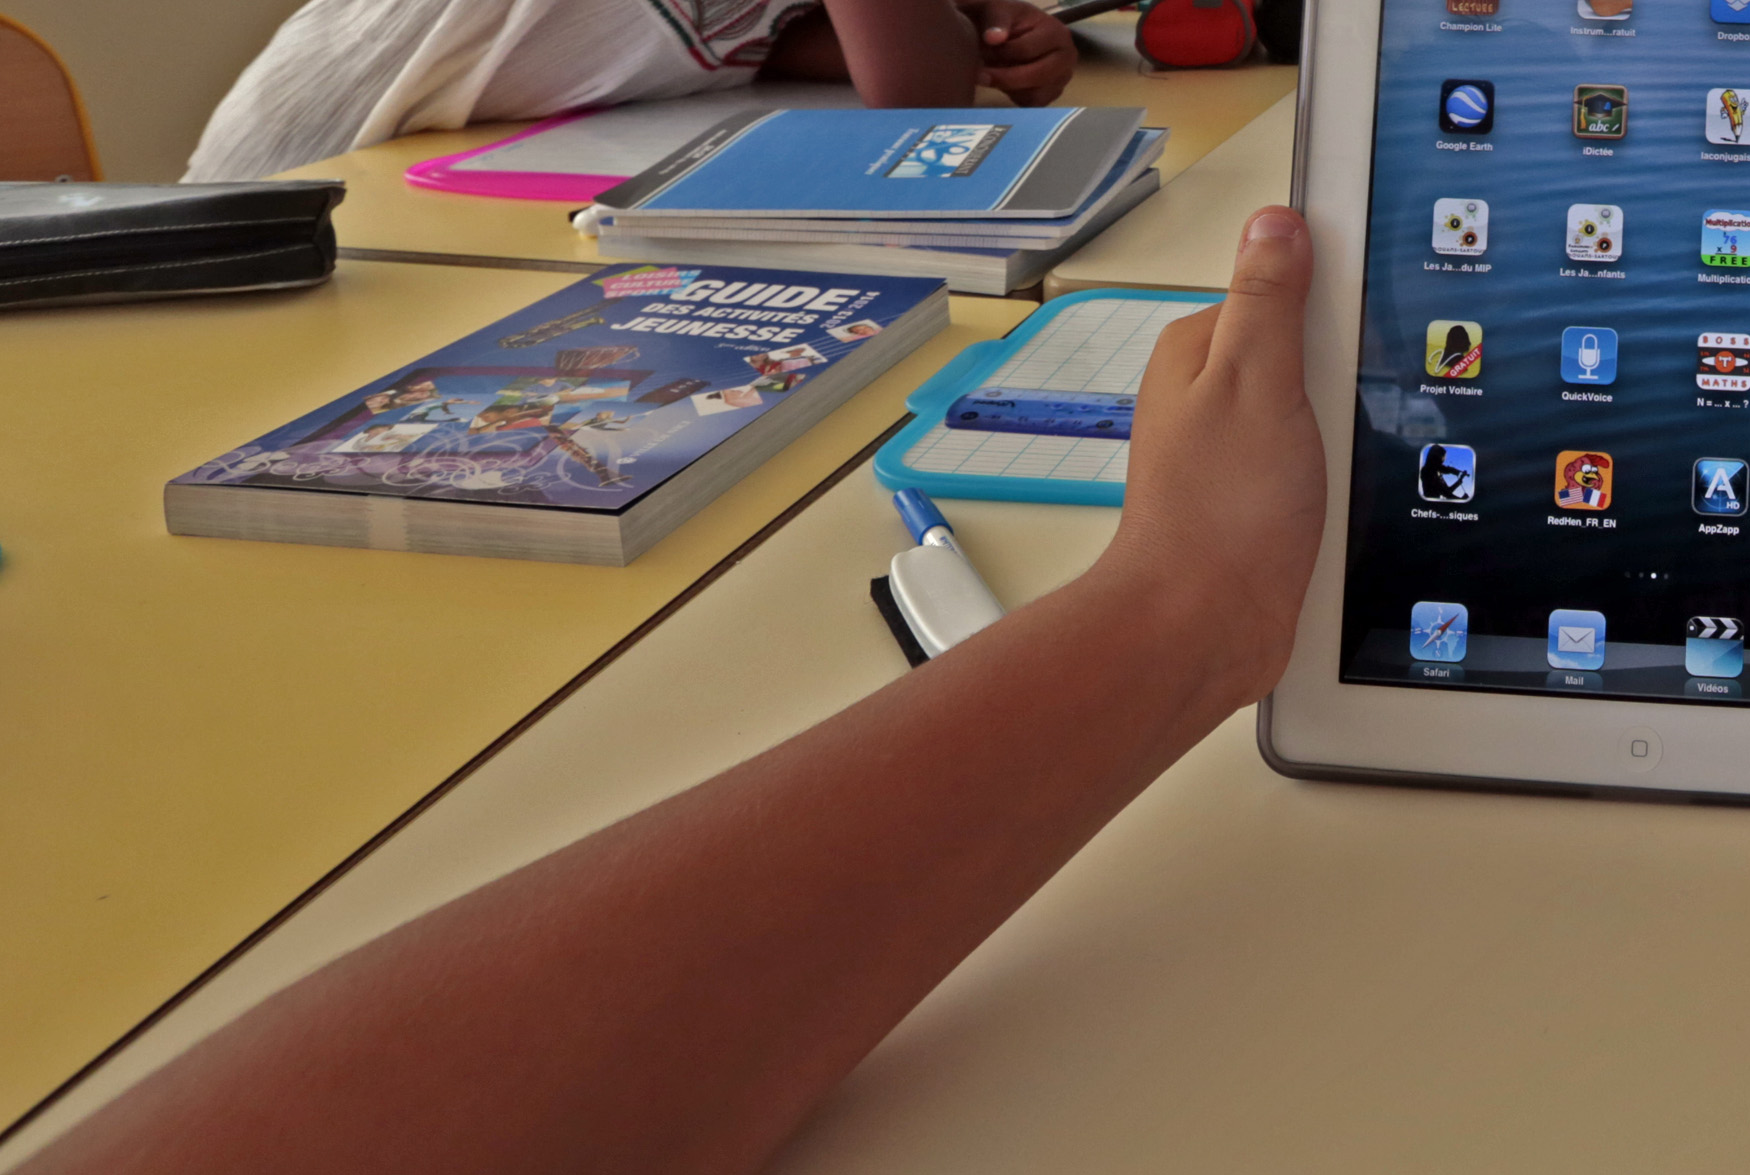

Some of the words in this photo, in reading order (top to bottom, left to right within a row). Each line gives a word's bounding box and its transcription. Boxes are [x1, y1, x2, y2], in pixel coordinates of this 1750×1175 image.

[1440, 21, 1484, 33] Champion
[1486, 23, 1502, 32] Lite
[1589, 120, 1609, 132] abc
[1436, 140, 1467, 152] Google
[1469, 142, 1493, 152] Earth
[1582, 146, 1614, 156] iDictée
[1723, 235, 1737, 245] 76
[1709, 256, 1748, 266] FREE
[1424, 261, 1440, 271] Les
[1474, 263, 1492, 273] MIP
[1560, 267, 1576, 277] Les
[669, 280, 861, 312] GUIDE
[641, 302, 674, 315] DES
[692, 303, 820, 325] ACTIVITÉS
[610, 316, 805, 342] JEUNESSE
[1702, 335, 1750, 346] BOSS
[1450, 348, 1481, 377] GRATUIT
[1701, 378, 1748, 388] MATHS
[1420, 384, 1446, 395] Projet
[1449, 386, 1483, 396] Voltaire
[1562, 392, 1613, 403] QuickVoice
[1726, 502, 1740, 510] HD
[1411, 509, 1478, 521] Chefs-...siques
[1548, 516, 1616, 528] RedHen_FR_EN
[1699, 524, 1739, 535] AppZapp
[1423, 667, 1449, 677] Safari
[1565, 675, 1584, 685] Mail
[1697, 683, 1728, 694] Vidéos
